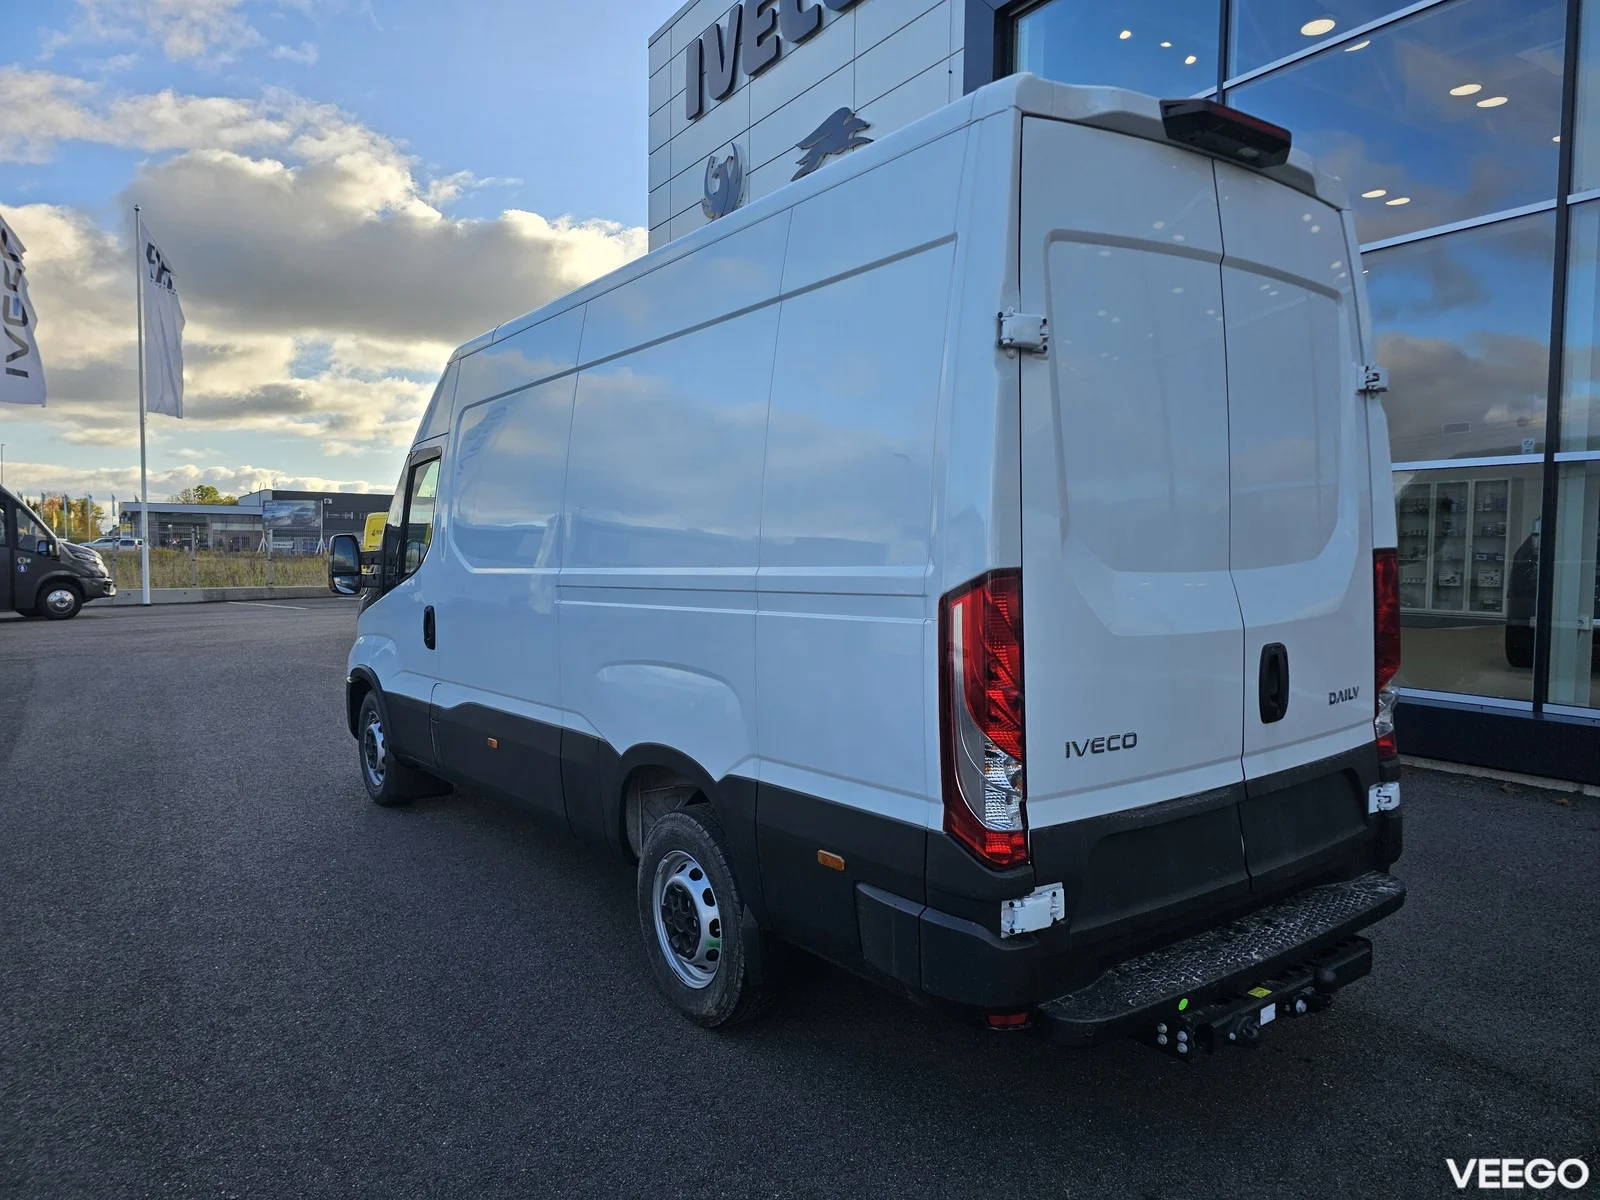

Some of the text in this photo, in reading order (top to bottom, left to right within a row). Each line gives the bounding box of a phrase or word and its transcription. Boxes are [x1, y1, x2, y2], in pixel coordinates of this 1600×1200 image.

[686, 0, 864, 121] IVEC
[1328, 685, 1360, 706] DAILY
[1065, 731, 1138, 759] IVECO
